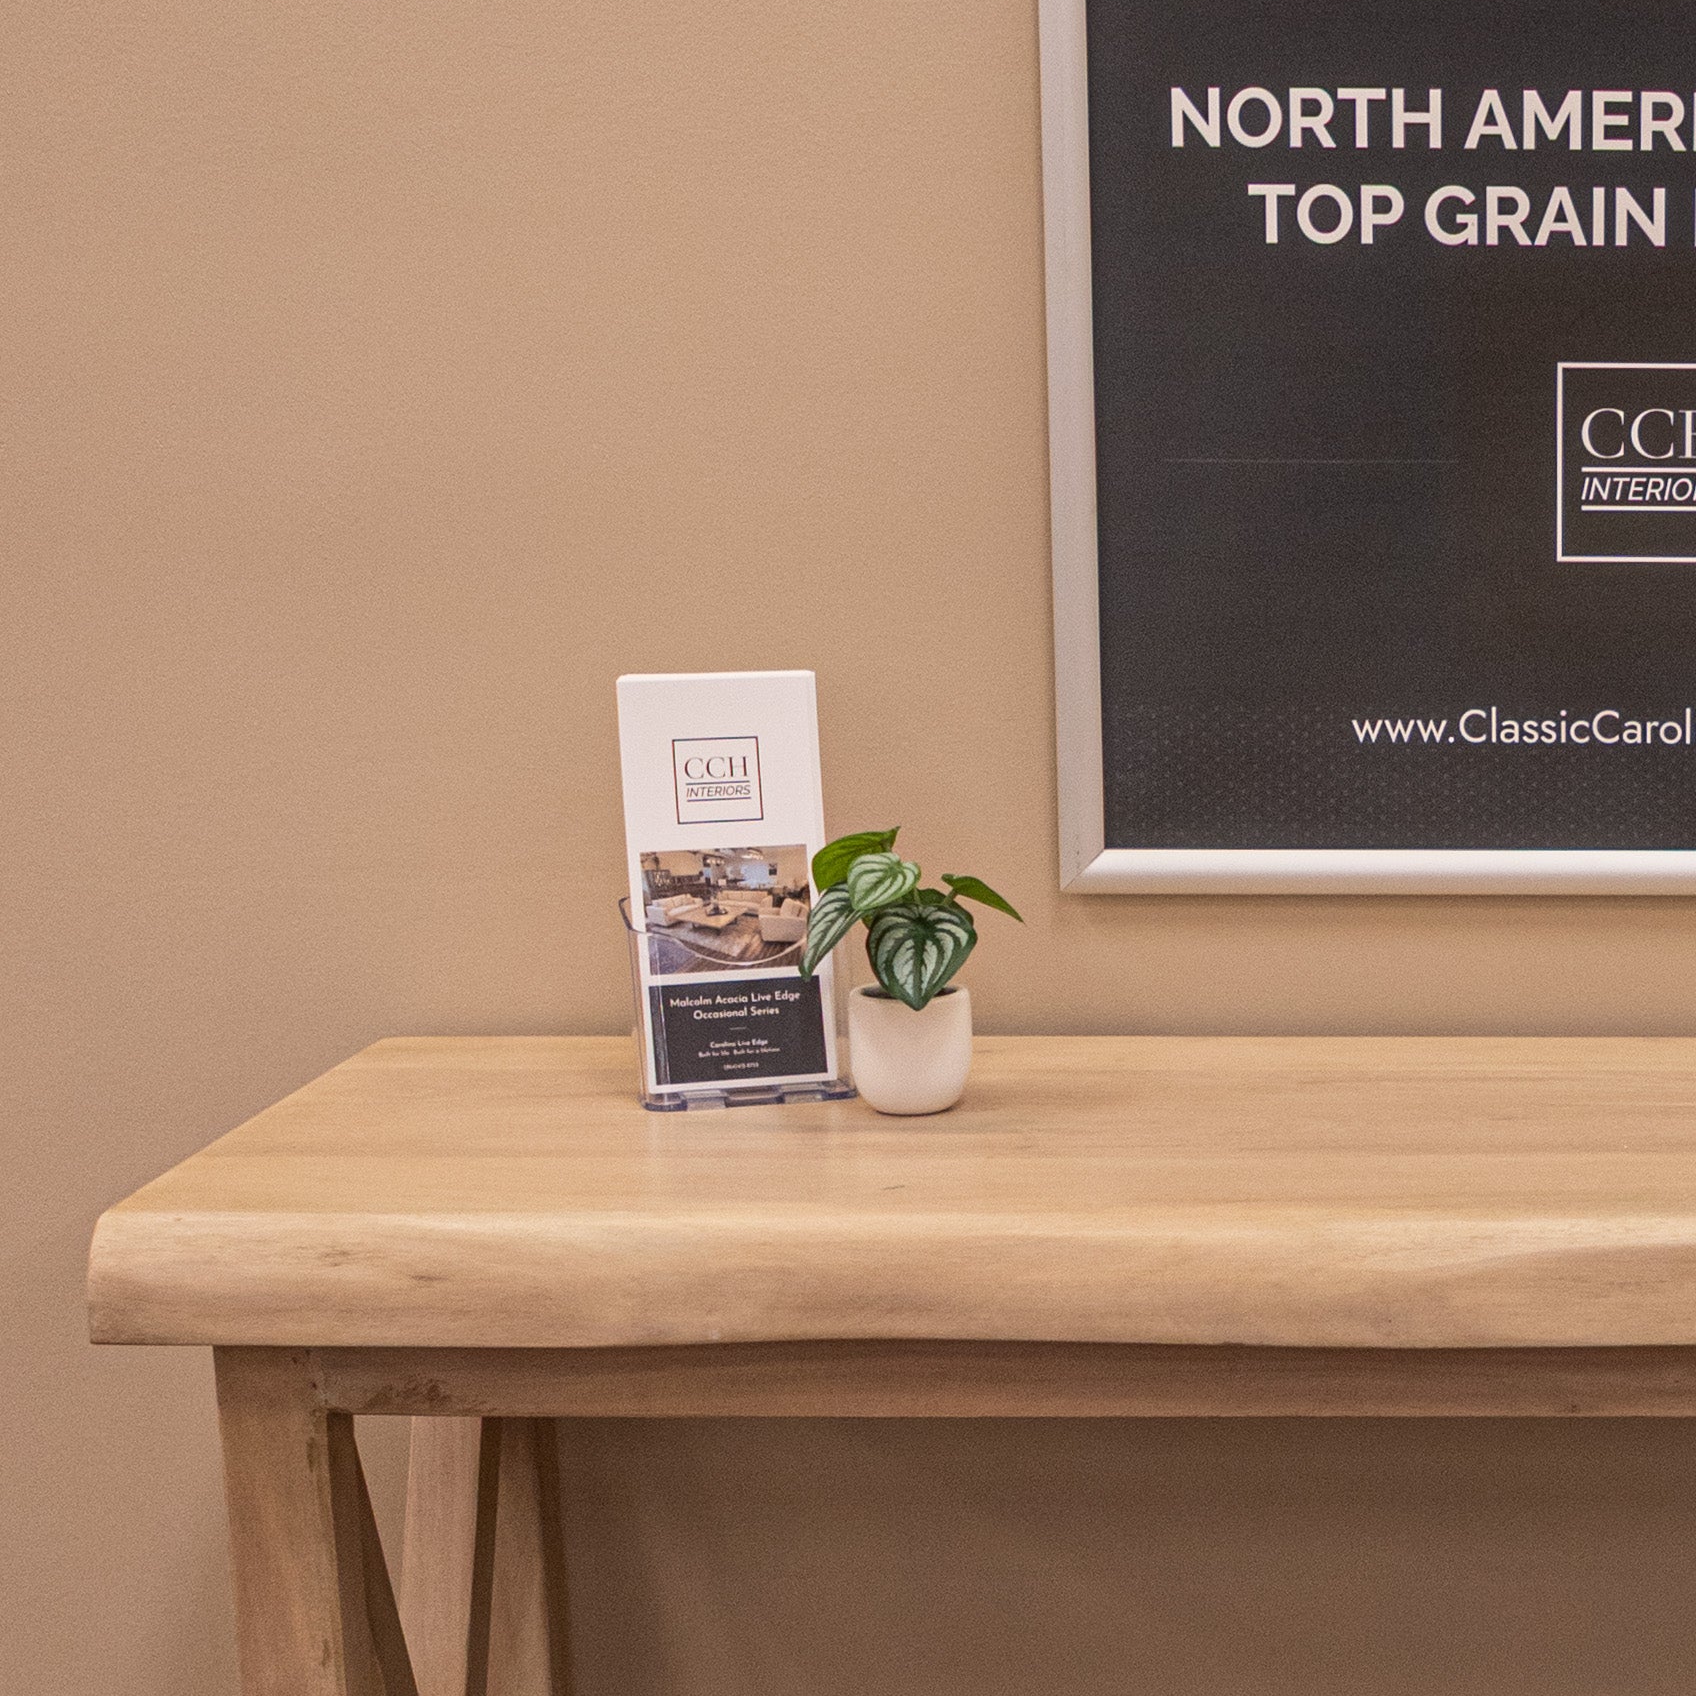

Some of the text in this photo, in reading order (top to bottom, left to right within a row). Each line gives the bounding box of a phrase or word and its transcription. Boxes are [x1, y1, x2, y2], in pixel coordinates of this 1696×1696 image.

[1169, 85, 1443, 150] NORTH
[1246, 182, 1406, 246] TOP
[1423, 183, 1667, 249] GRAIN
[684, 756, 749, 780] CCH
[686, 784, 751, 798] INTERIORS
[669, 990, 801, 1008] Malcolm Acacia Live Edge
[693, 1005, 780, 1020] Occasional Series
